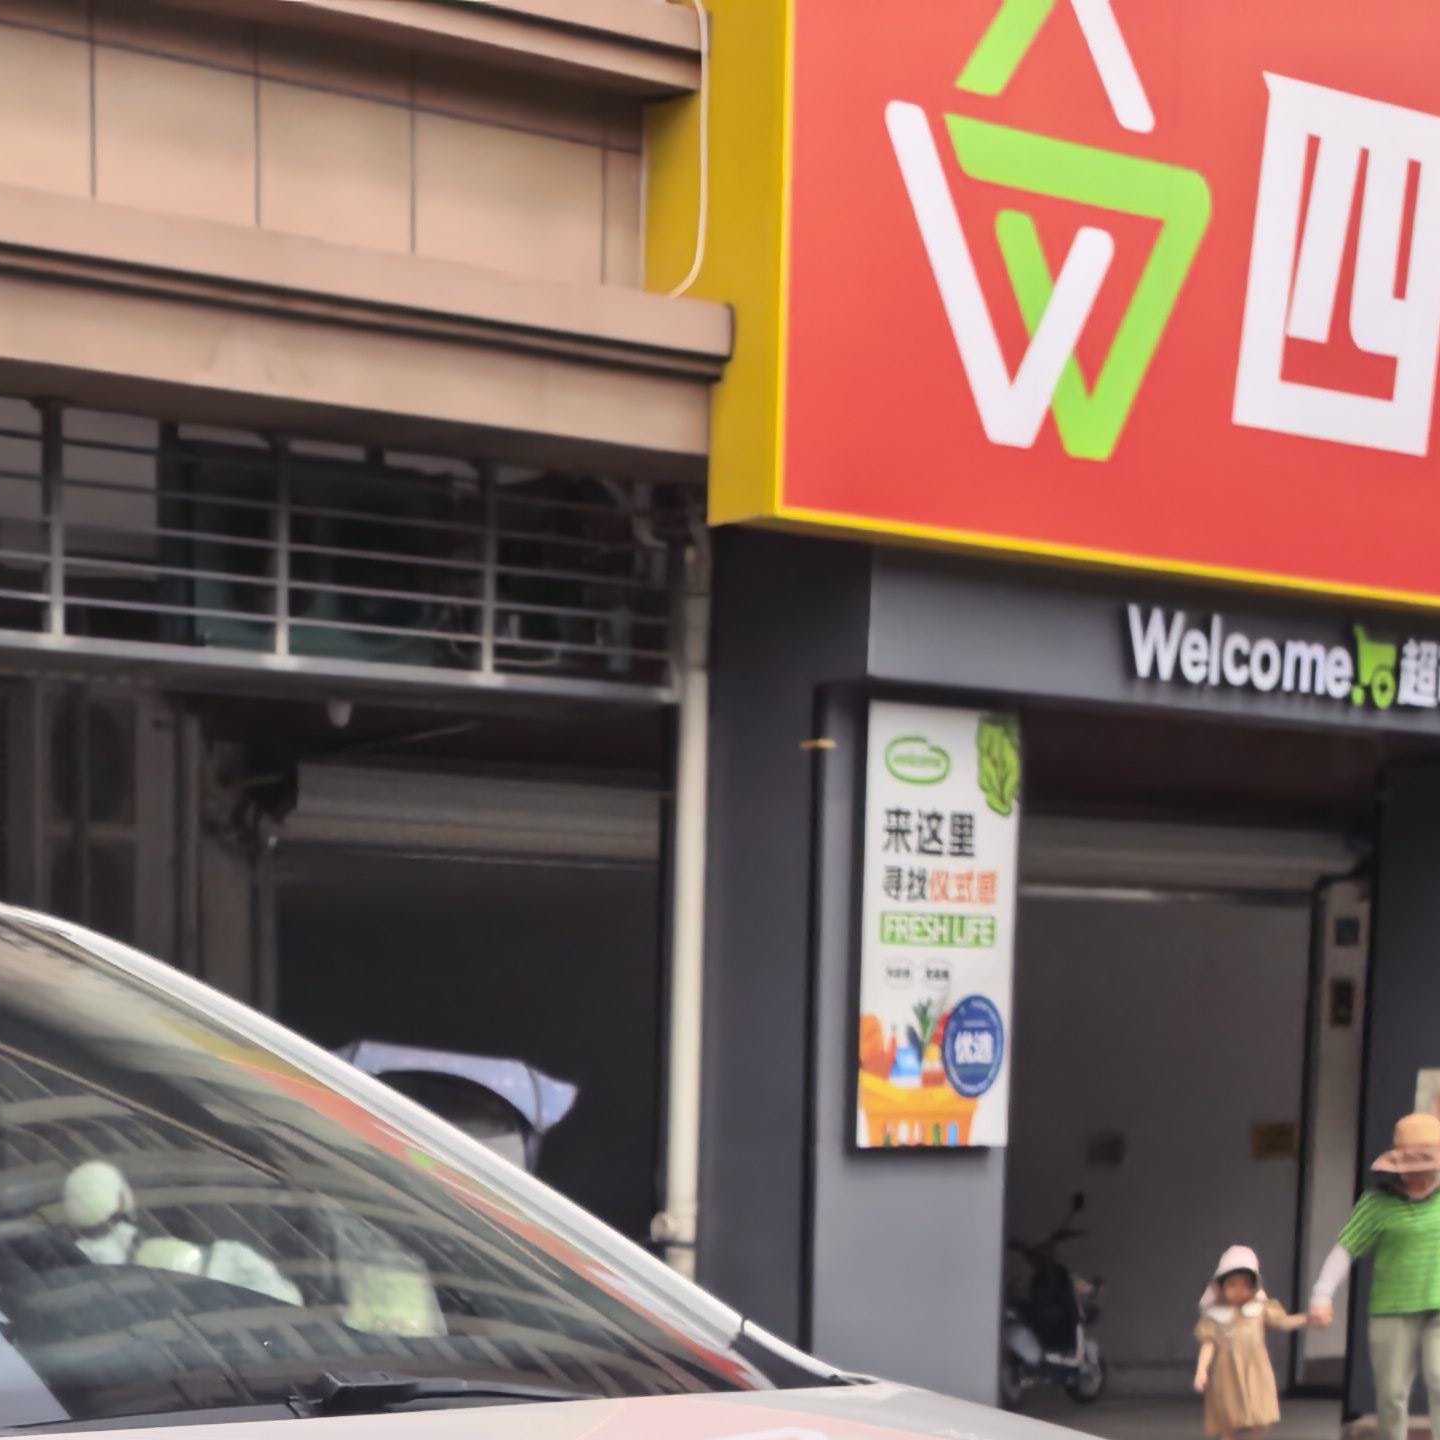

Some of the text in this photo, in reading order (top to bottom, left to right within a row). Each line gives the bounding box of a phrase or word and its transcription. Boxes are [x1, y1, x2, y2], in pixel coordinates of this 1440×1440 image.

[1128, 603, 1353, 698] Welcome
[882, 807, 977, 858] 来这里
